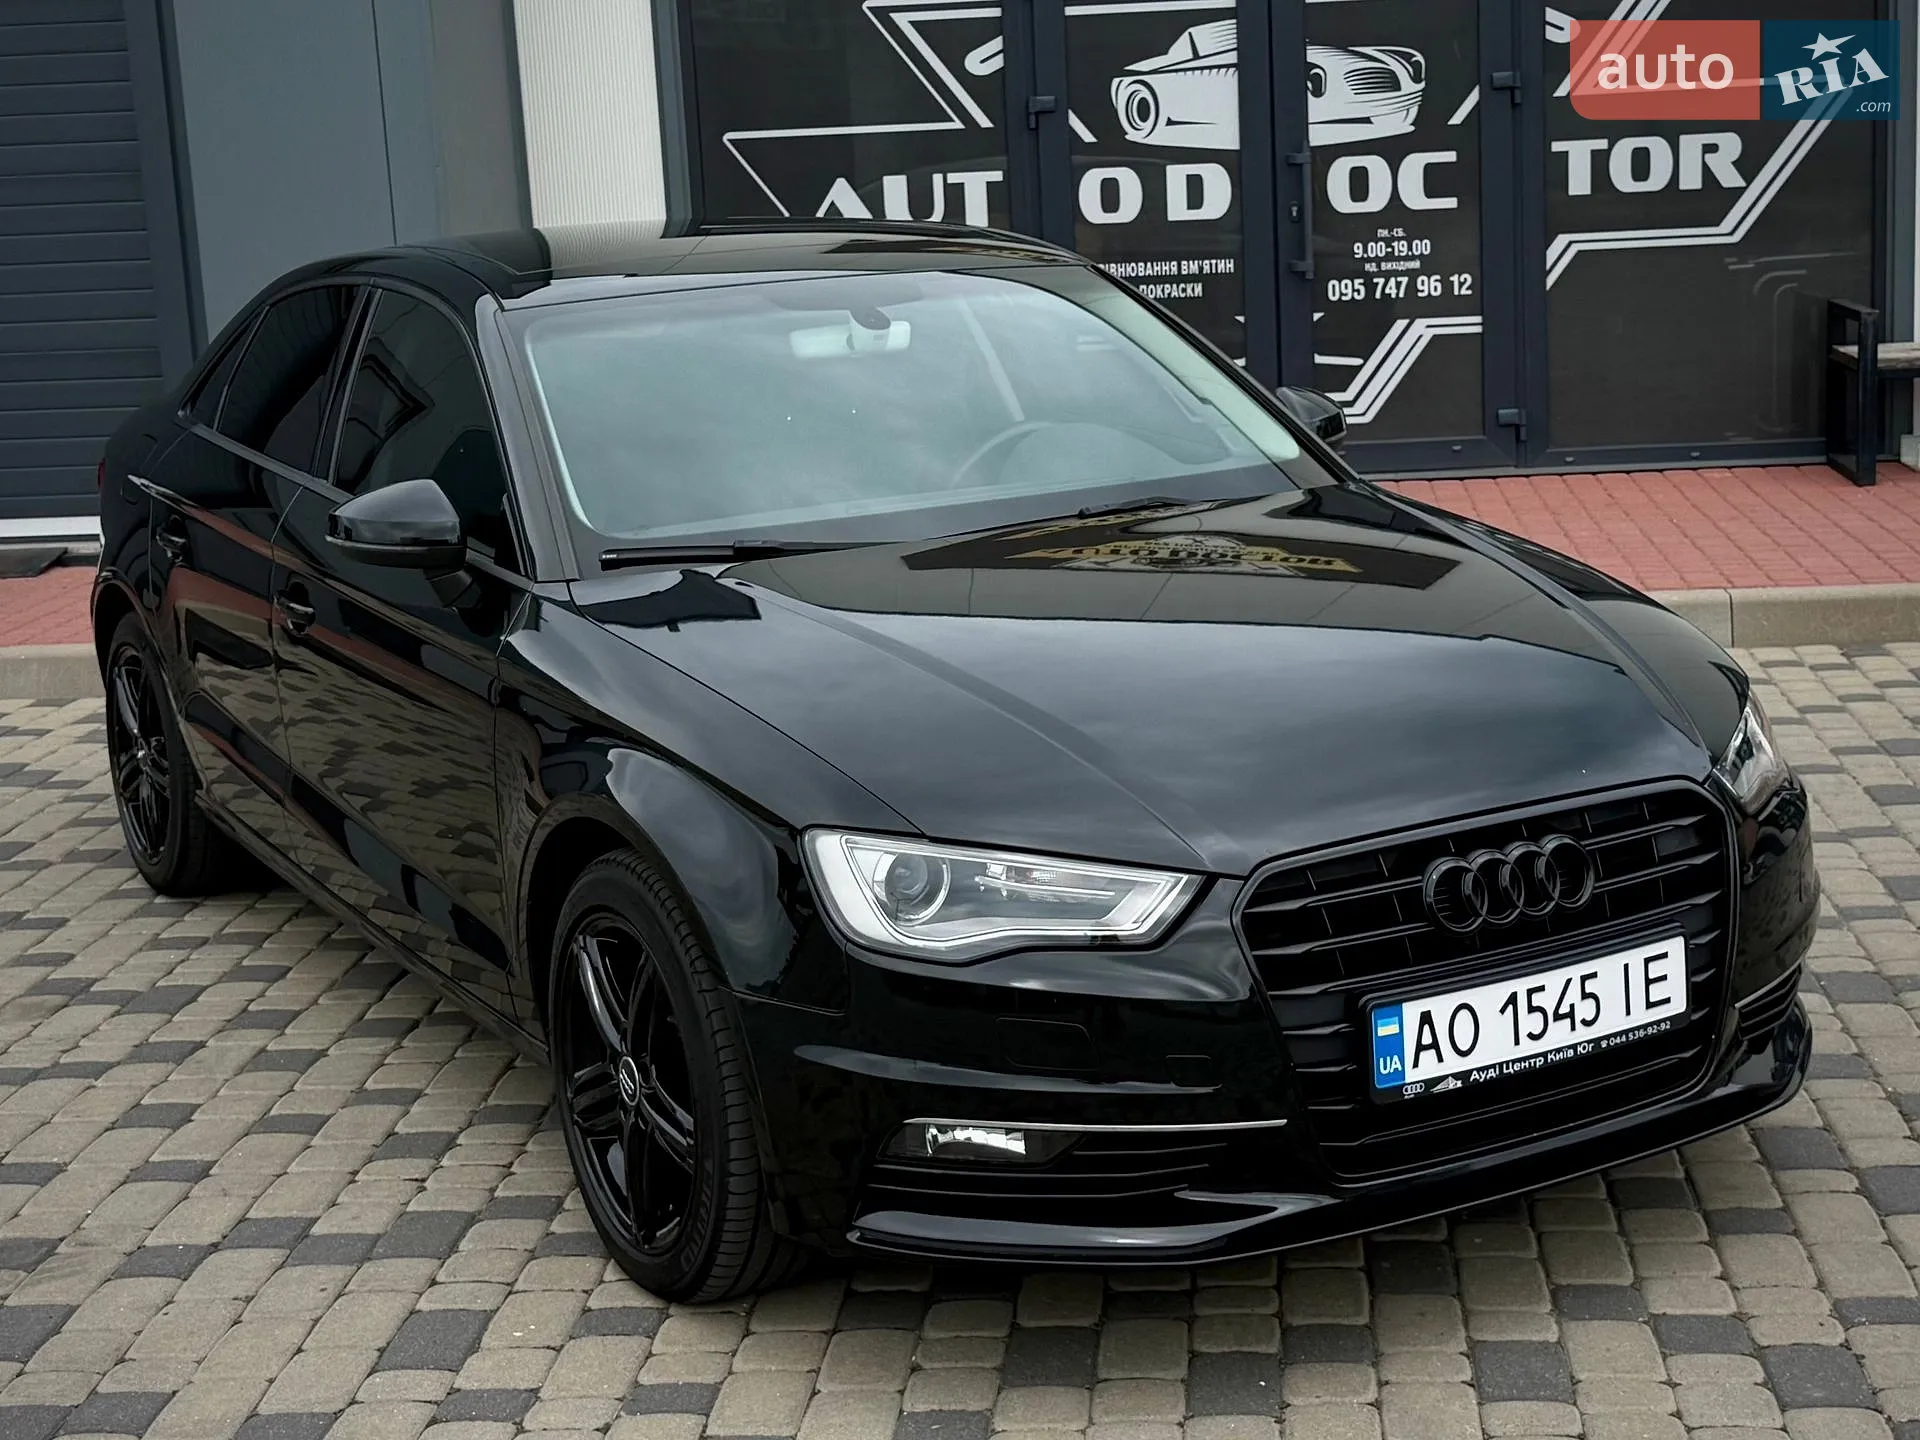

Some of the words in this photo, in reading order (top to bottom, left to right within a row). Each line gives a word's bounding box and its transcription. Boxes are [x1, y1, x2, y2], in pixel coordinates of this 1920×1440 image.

[1353, 239, 1431, 258] 9.00-19.00
[1327, 279, 1366, 301] 095
[1373, 277, 1408, 299] 747
[1416, 275, 1442, 297] 96
[1449, 273, 1472, 296] 12
[1498, 970, 1600, 1046] 1545
[1609, 1034, 1627, 1047] 044
[1628, 1020, 1672, 1041] 536-92-92
[1379, 1054, 1403, 1075] UA
[1503, 1055, 1545, 1075] Центр
[1547, 1047, 1575, 1063] Київ
